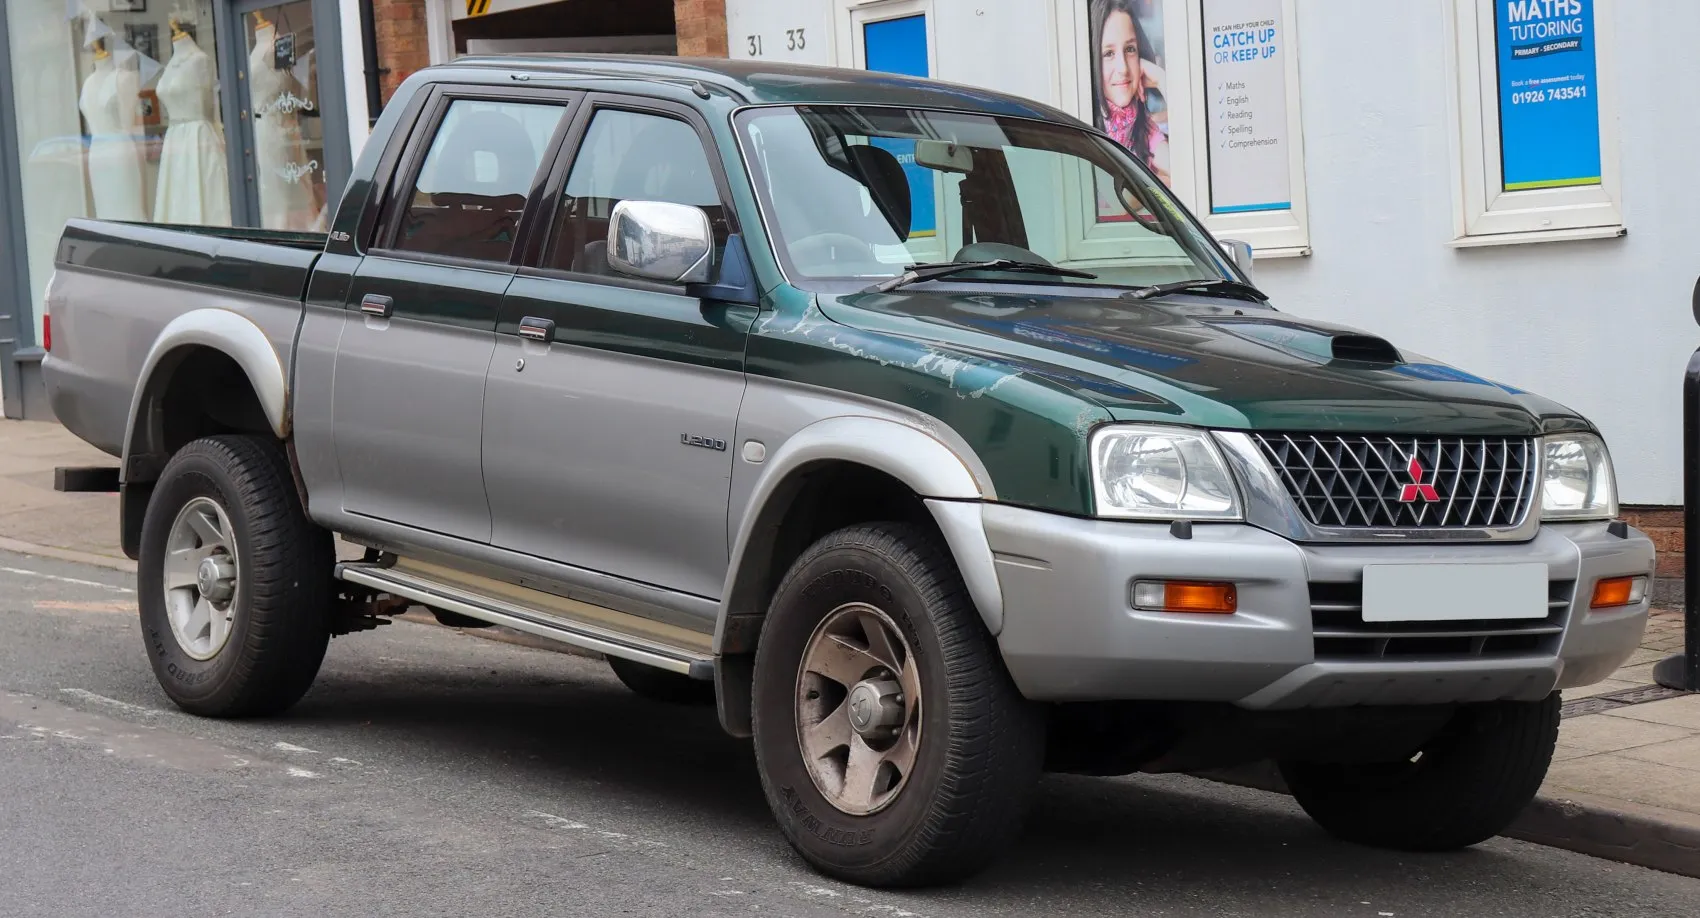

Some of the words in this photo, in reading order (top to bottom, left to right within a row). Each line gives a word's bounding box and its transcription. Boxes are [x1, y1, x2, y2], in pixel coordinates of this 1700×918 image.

[1508, 0, 1582, 22] MATHS
[1213, 31, 1254, 48] CATCH
[1259, 28, 1275, 43] UP
[1509, 18, 1583, 41] TUTORING
[747, 35, 763, 56] 31
[786, 28, 805, 51] 33
[1515, 47, 1539, 56] PRIMARY
[1543, 41, 1578, 52] SECONDARY
[1214, 51, 1229, 64] OR
[1232, 48, 1258, 62] KEEP
[1262, 46, 1276, 59] UP
[1226, 81, 1246, 90] Maths
[1512, 90, 1545, 104] 01926
[1547, 85, 1586, 101] 743541
[1227, 94, 1249, 106] English
[1228, 110, 1253, 120] Reading
[1228, 124, 1253, 136] Spelling
[1229, 137, 1278, 150] Comprehension
[680, 432, 726, 452] L200
